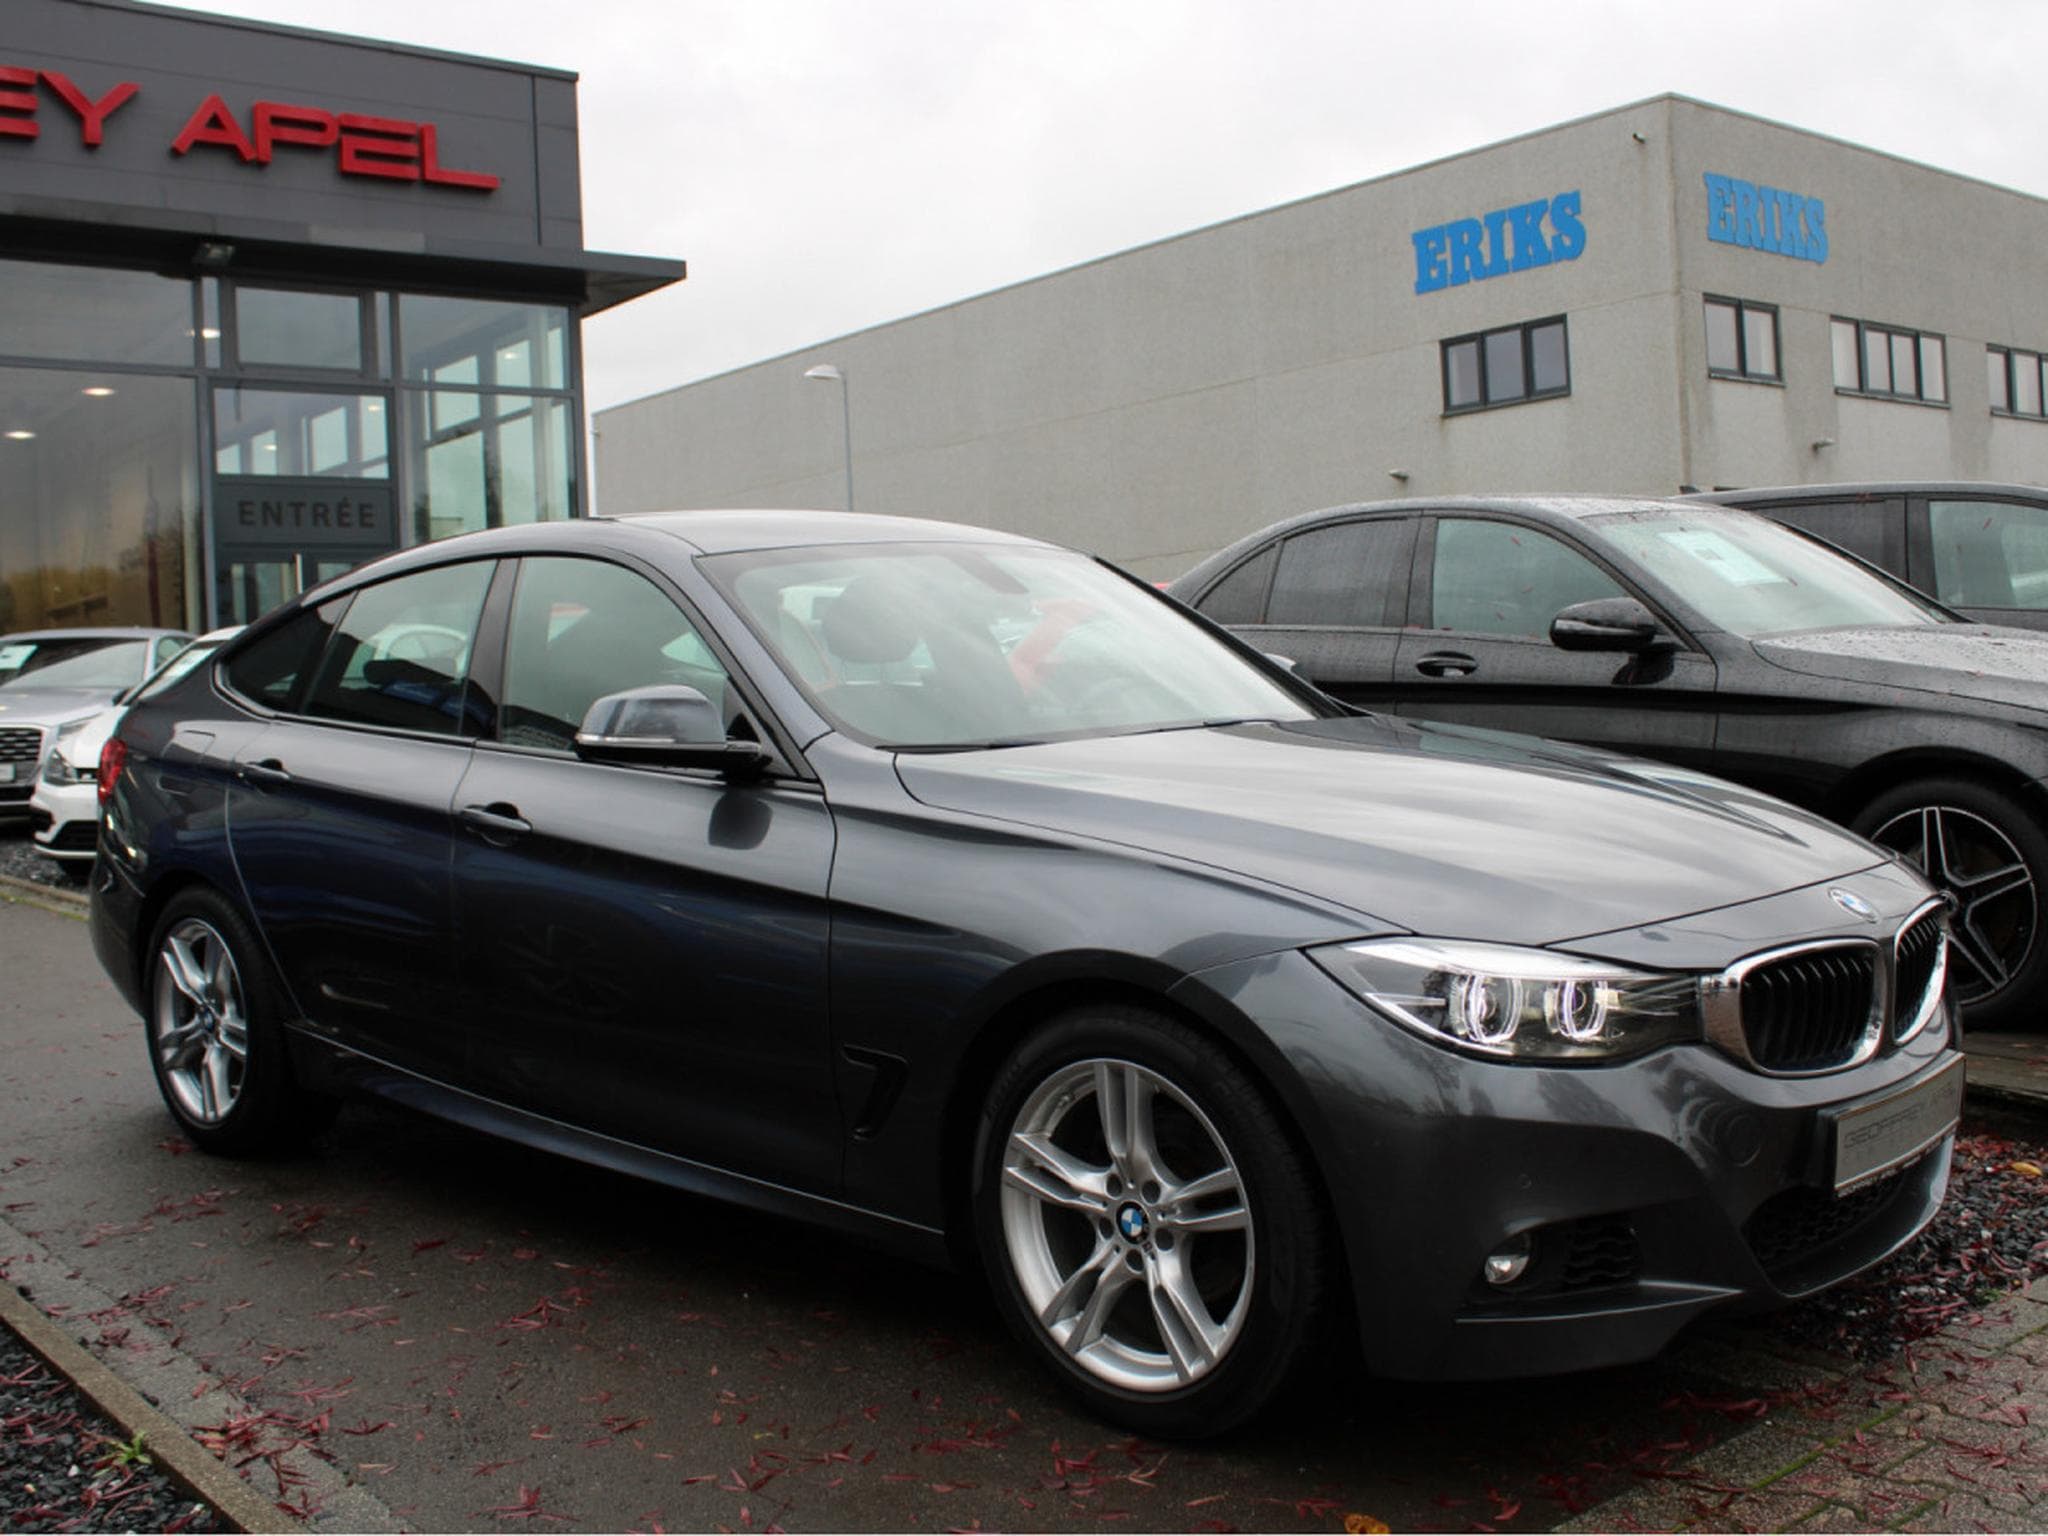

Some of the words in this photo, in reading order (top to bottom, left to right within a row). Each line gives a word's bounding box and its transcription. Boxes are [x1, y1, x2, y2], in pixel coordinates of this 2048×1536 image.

[171, 94, 501, 191] APEL
[1412, 190, 1587, 294] ERIKS
[1704, 172, 1829, 263] ERIKS
[238, 496, 377, 528] ENTRÉE
